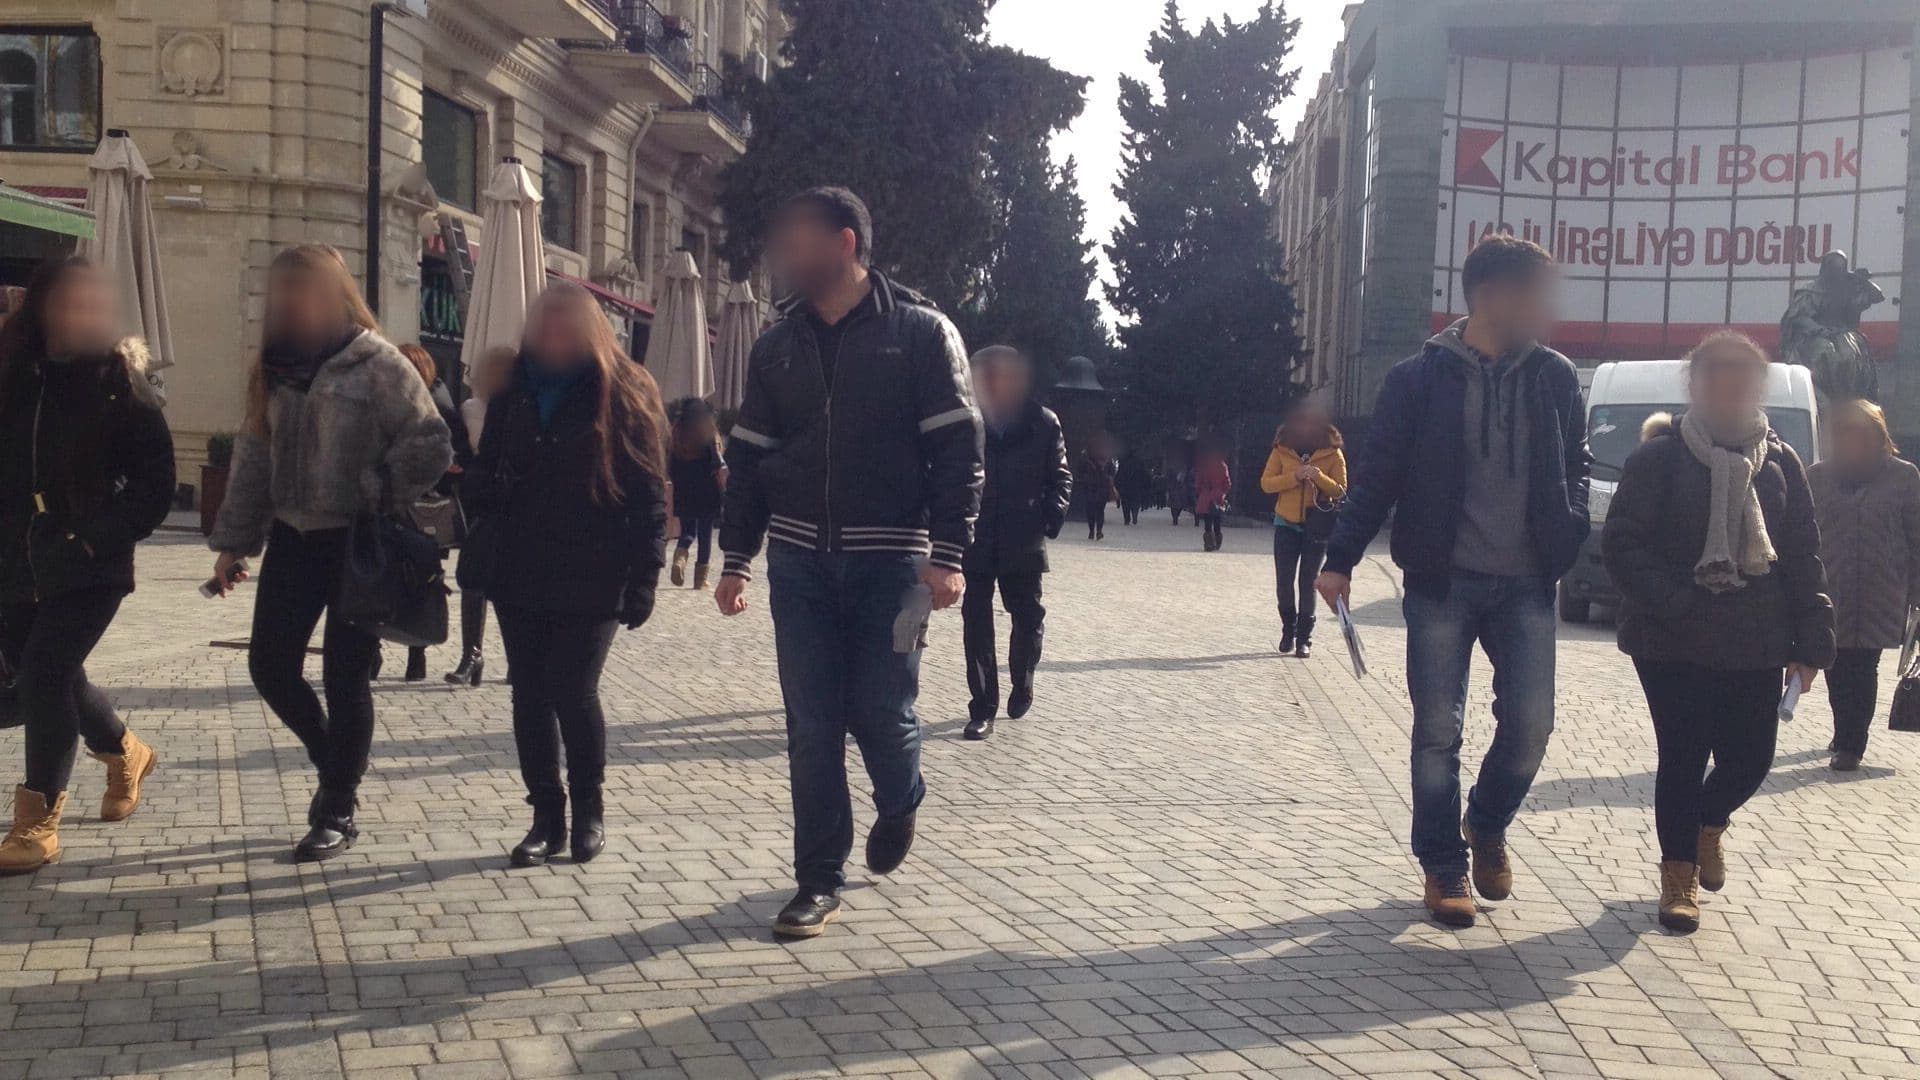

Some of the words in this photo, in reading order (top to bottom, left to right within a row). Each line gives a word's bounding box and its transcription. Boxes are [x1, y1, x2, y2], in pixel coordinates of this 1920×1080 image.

[1513, 139, 1701, 196] Kapital
[1717, 137, 1859, 184] Bank
[1705, 221, 1833, 266] DOĞRU
